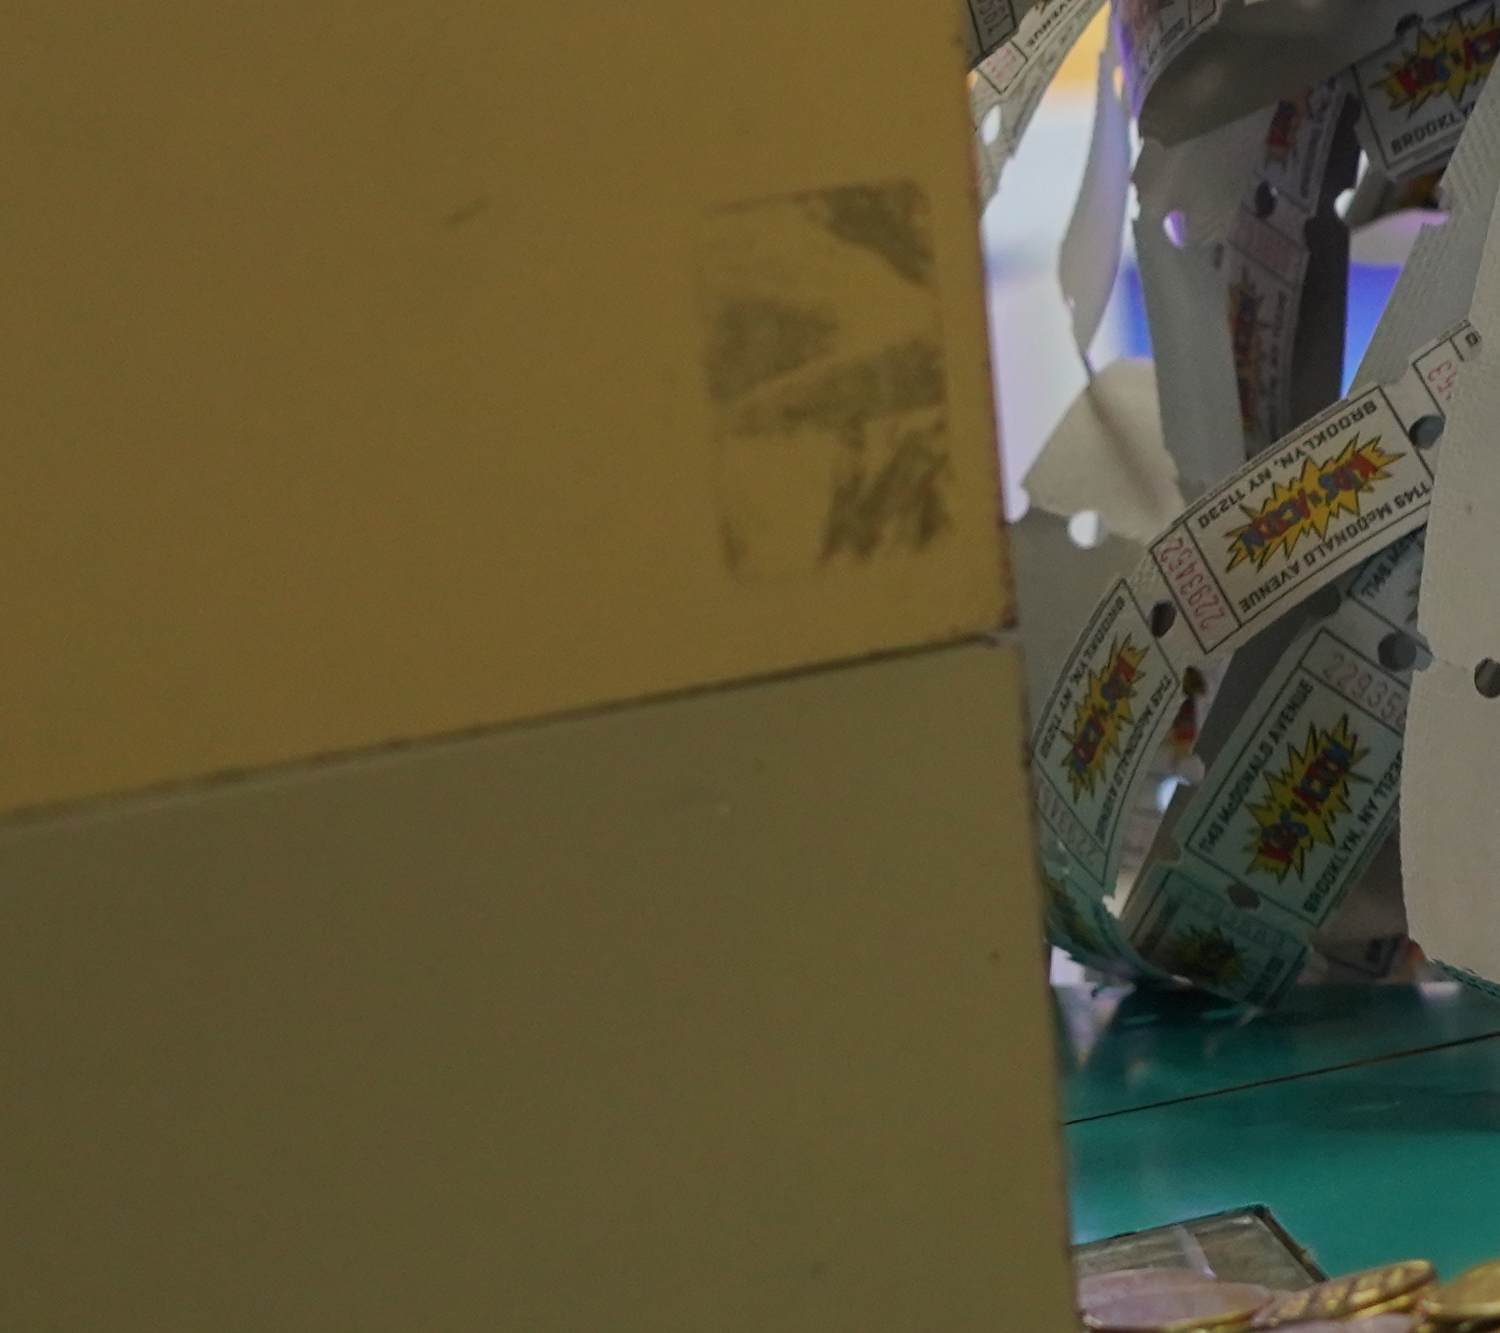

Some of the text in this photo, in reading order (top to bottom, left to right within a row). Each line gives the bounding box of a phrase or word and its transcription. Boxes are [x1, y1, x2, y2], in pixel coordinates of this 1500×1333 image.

[1198, 400, 1378, 529] BROOKLYN, NY 11230
[1241, 453, 1378, 554] KIDS ACTION
[1239, 481, 1430, 613] 1149 McDONALD AVENUE
[1058, 692, 1073, 721] NY
[1272, 679, 1315, 744] AVENUE
[1358, 796, 1378, 823] NY
